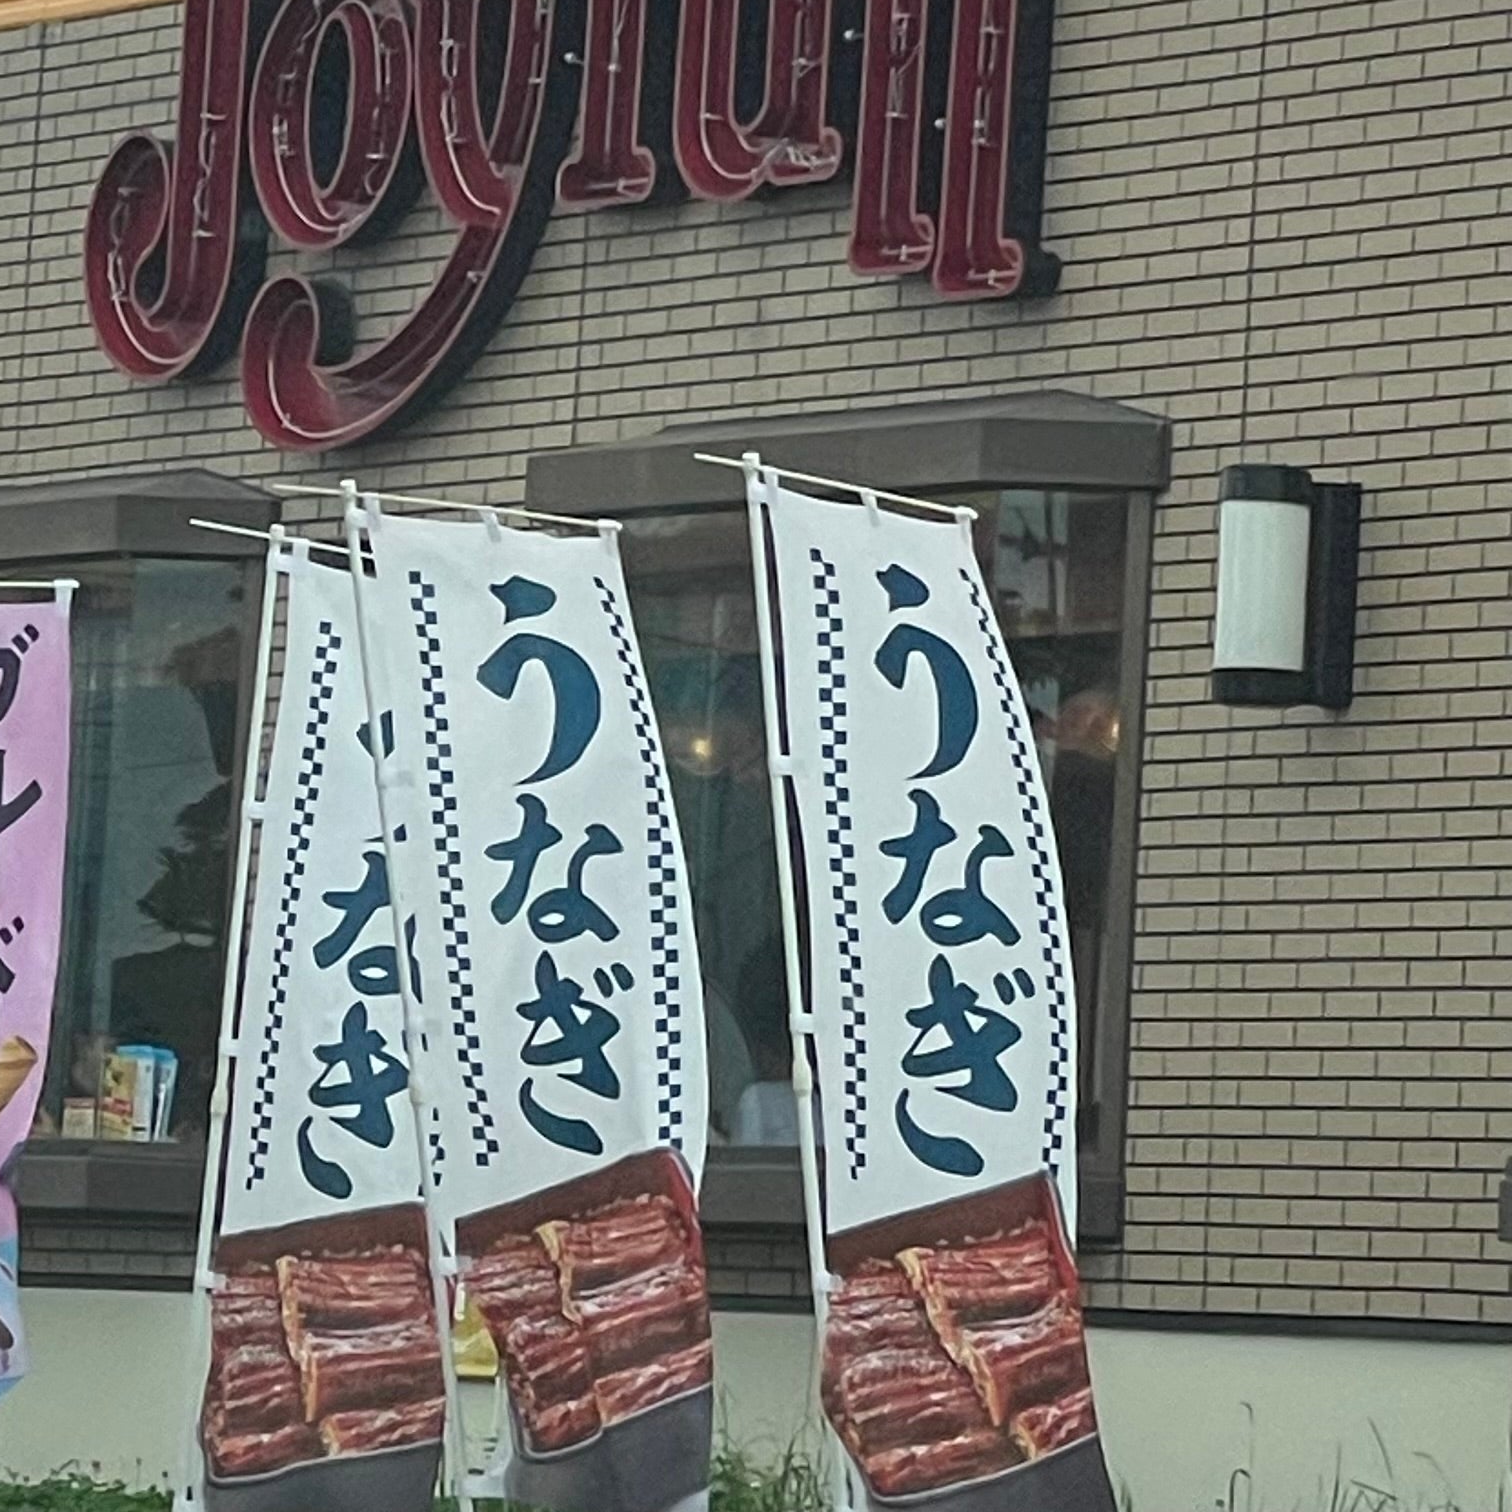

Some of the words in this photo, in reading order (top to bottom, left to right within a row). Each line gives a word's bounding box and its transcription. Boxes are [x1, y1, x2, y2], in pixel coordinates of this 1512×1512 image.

[477, 574, 634, 1155] うなぎ
[874, 563, 1035, 1177] うなぎ
